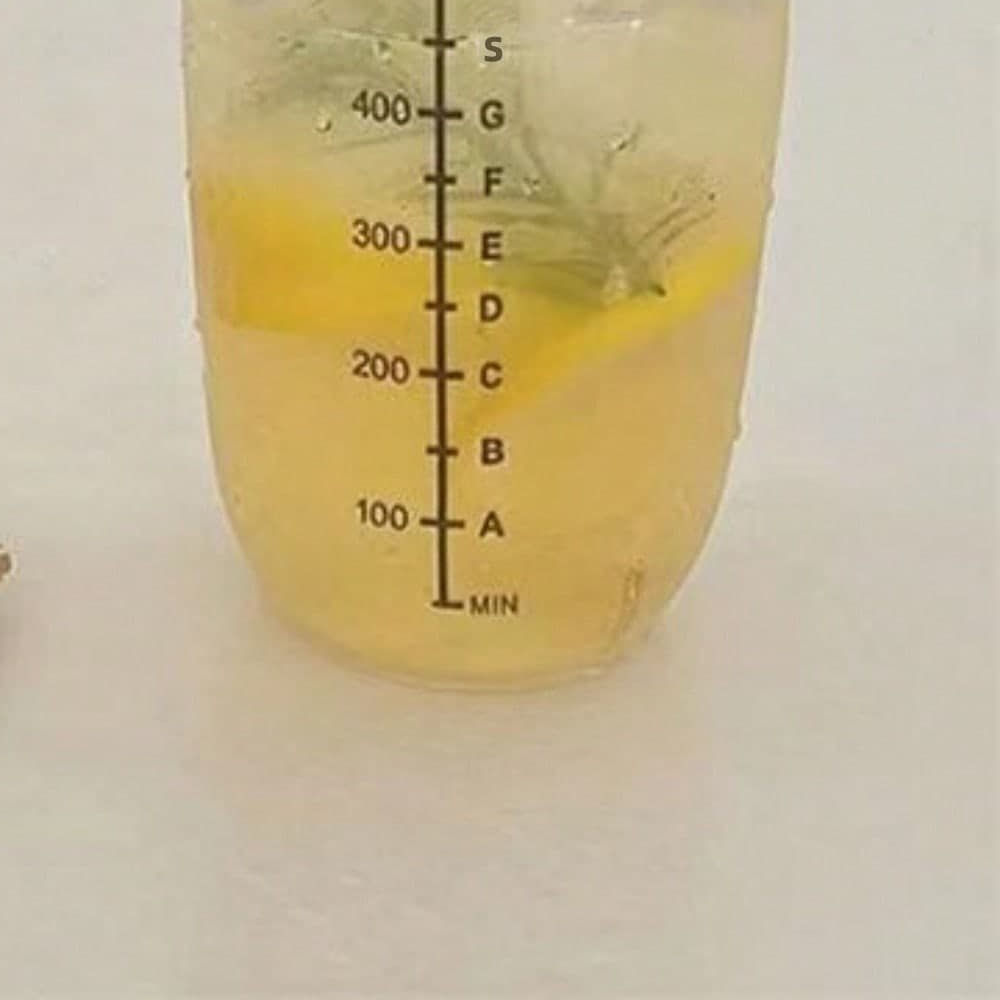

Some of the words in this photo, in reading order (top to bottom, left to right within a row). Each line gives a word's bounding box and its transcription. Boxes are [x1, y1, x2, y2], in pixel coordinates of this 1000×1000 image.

[483, 36, 504, 63] S
[351, 88, 412, 126] 400
[479, 99, 506, 130] G
[483, 166, 504, 197] F
[352, 218, 411, 254] 300
[480, 230, 503, 261] E
[479, 293, 503, 323] D
[351, 348, 410, 385] 200
[479, 361, 503, 389] C
[480, 437, 505, 466] B
[356, 498, 409, 531] 100
[479, 510, 505, 537] A
[469, 595, 519, 615] MIN
